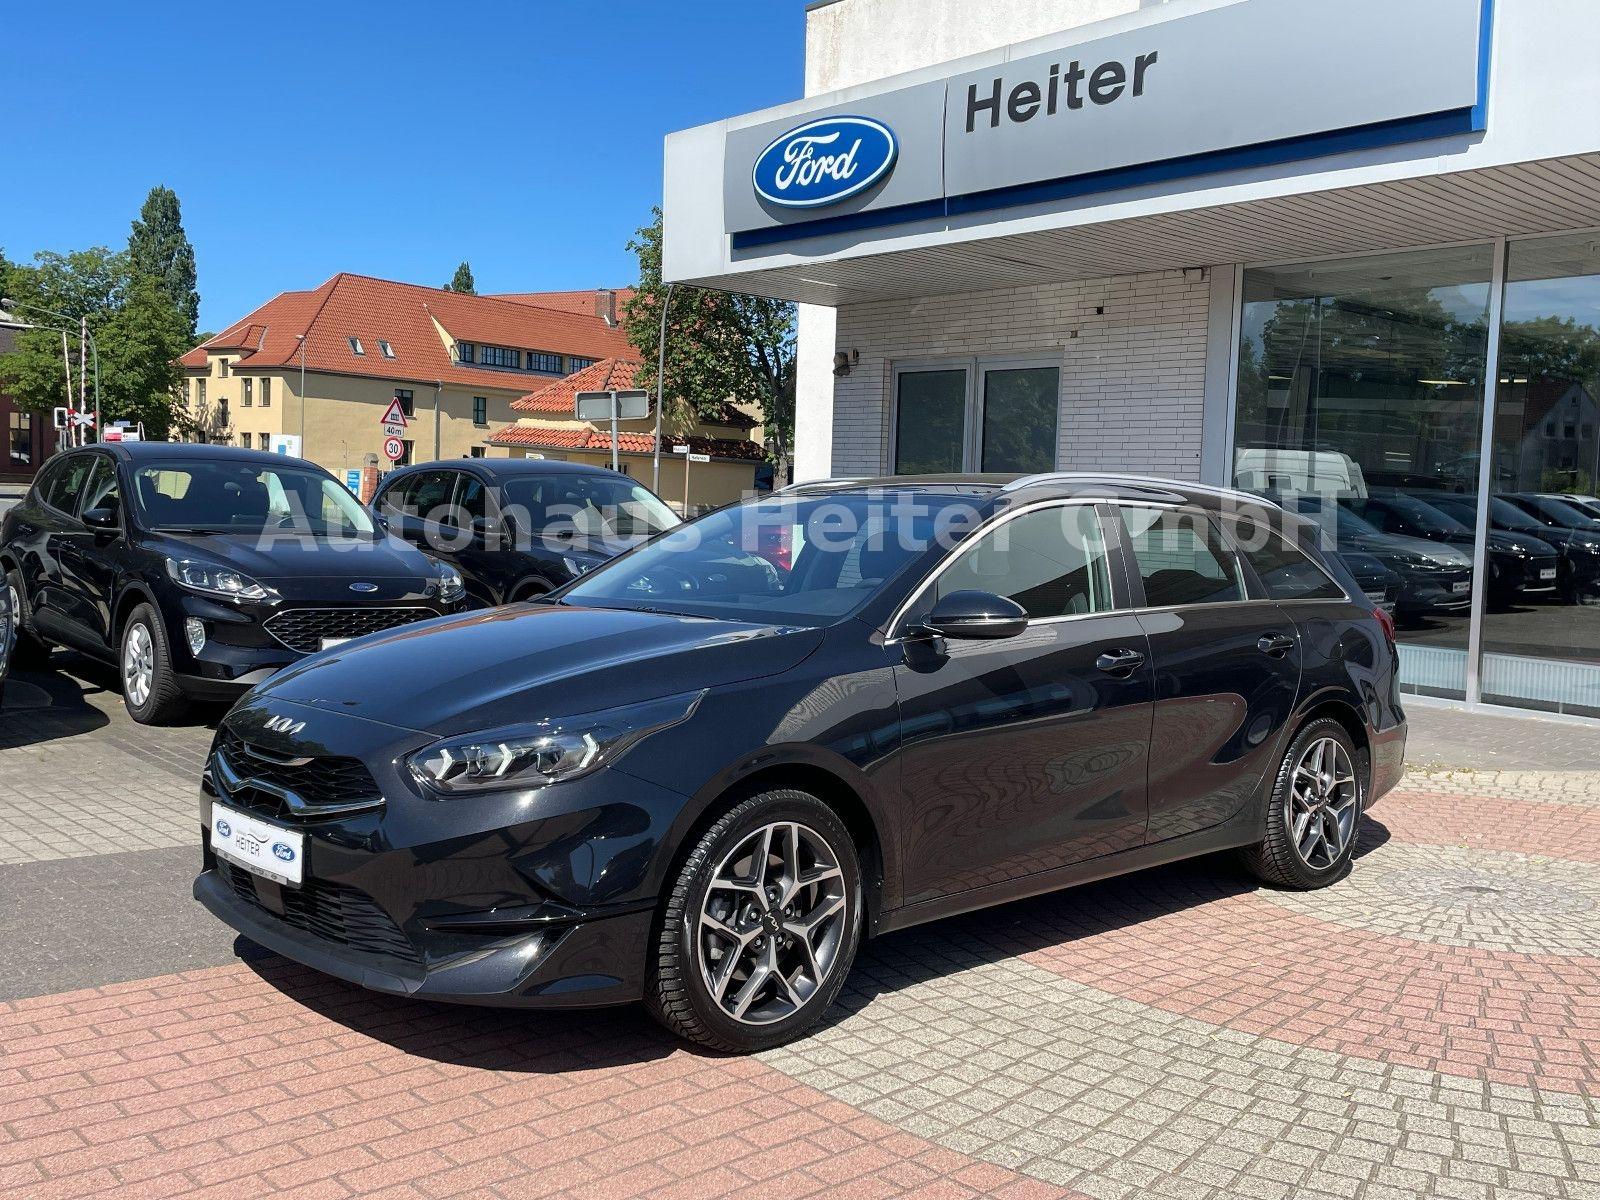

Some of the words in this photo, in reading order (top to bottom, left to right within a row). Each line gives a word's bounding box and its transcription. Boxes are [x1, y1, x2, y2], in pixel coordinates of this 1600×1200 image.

[965, 50, 1159, 133] Heiter
[775, 131, 862, 190] Ford
[386, 427, 395, 435] 40
[388, 443, 399, 454] 30
[235, 835, 261, 857] HEITER
[275, 844, 293, 859] Ford
